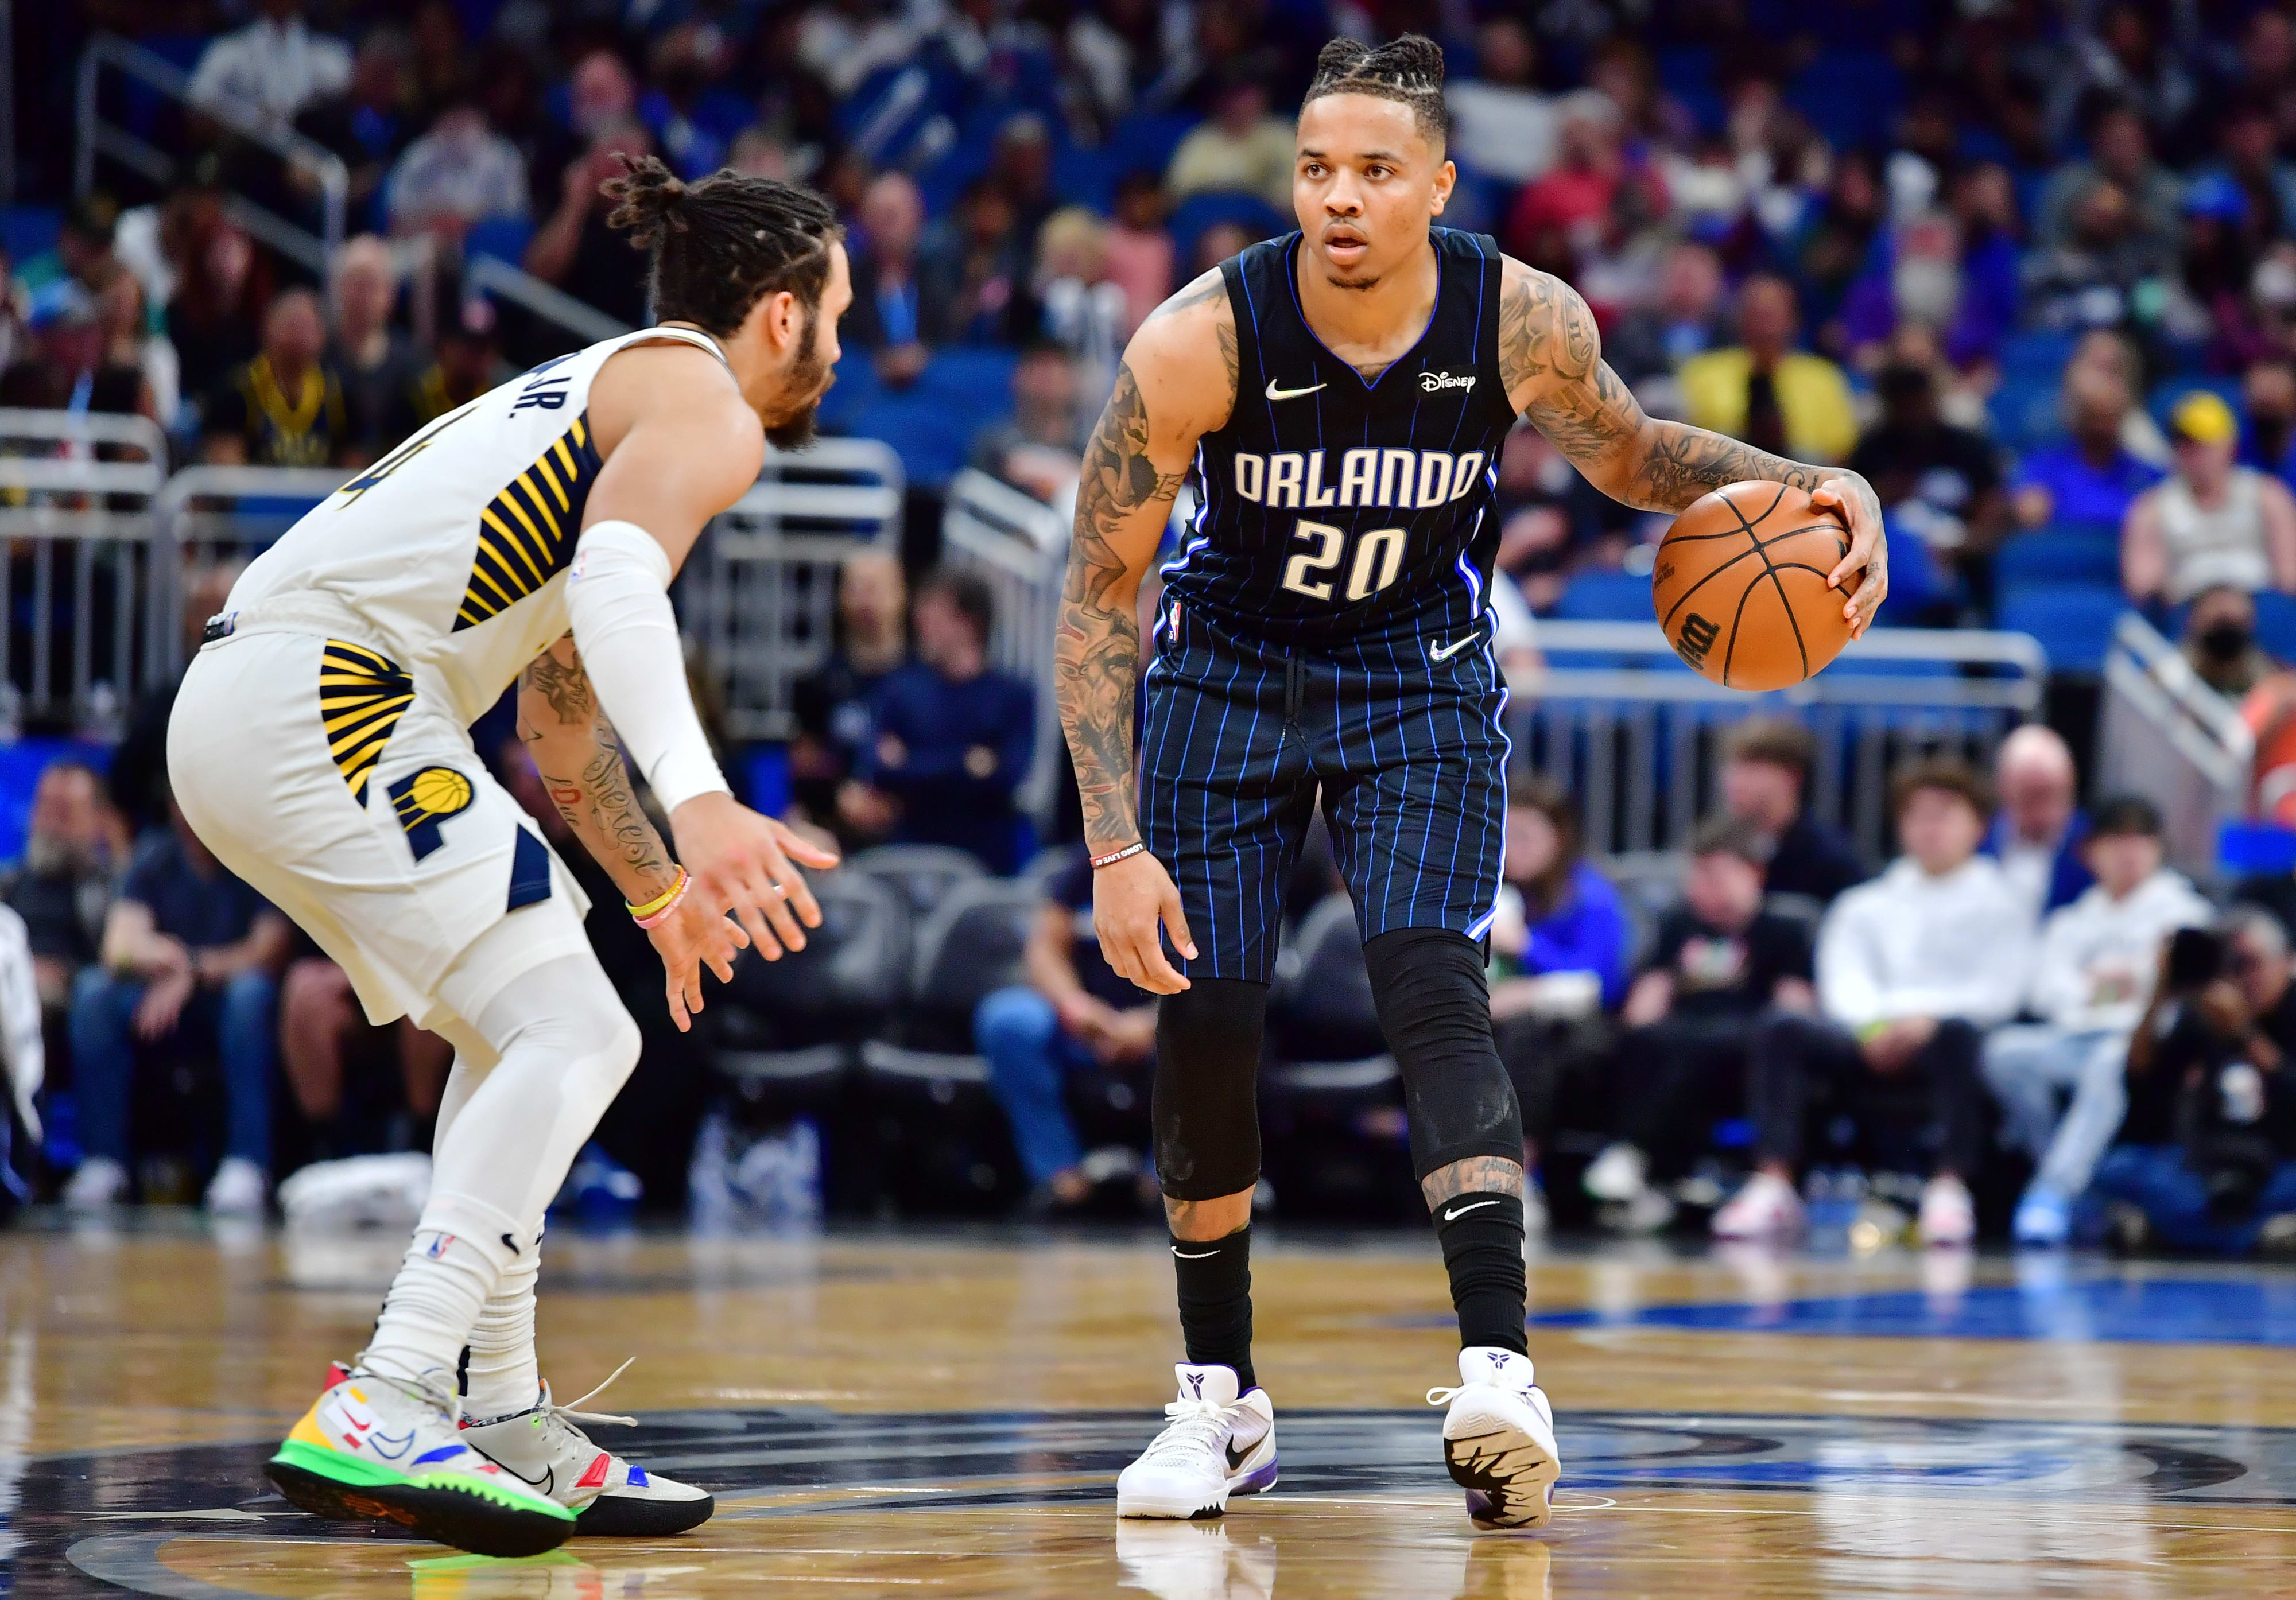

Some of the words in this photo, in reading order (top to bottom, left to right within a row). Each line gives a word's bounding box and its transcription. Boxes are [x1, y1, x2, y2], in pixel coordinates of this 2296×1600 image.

[1418, 371, 1476, 394] Disney
[1234, 447, 1486, 510] ORLANDO
[1281, 518, 1407, 603] 20
[1102, 853, 1121, 864] LIVE
[1121, 843, 1143, 857] LONG
